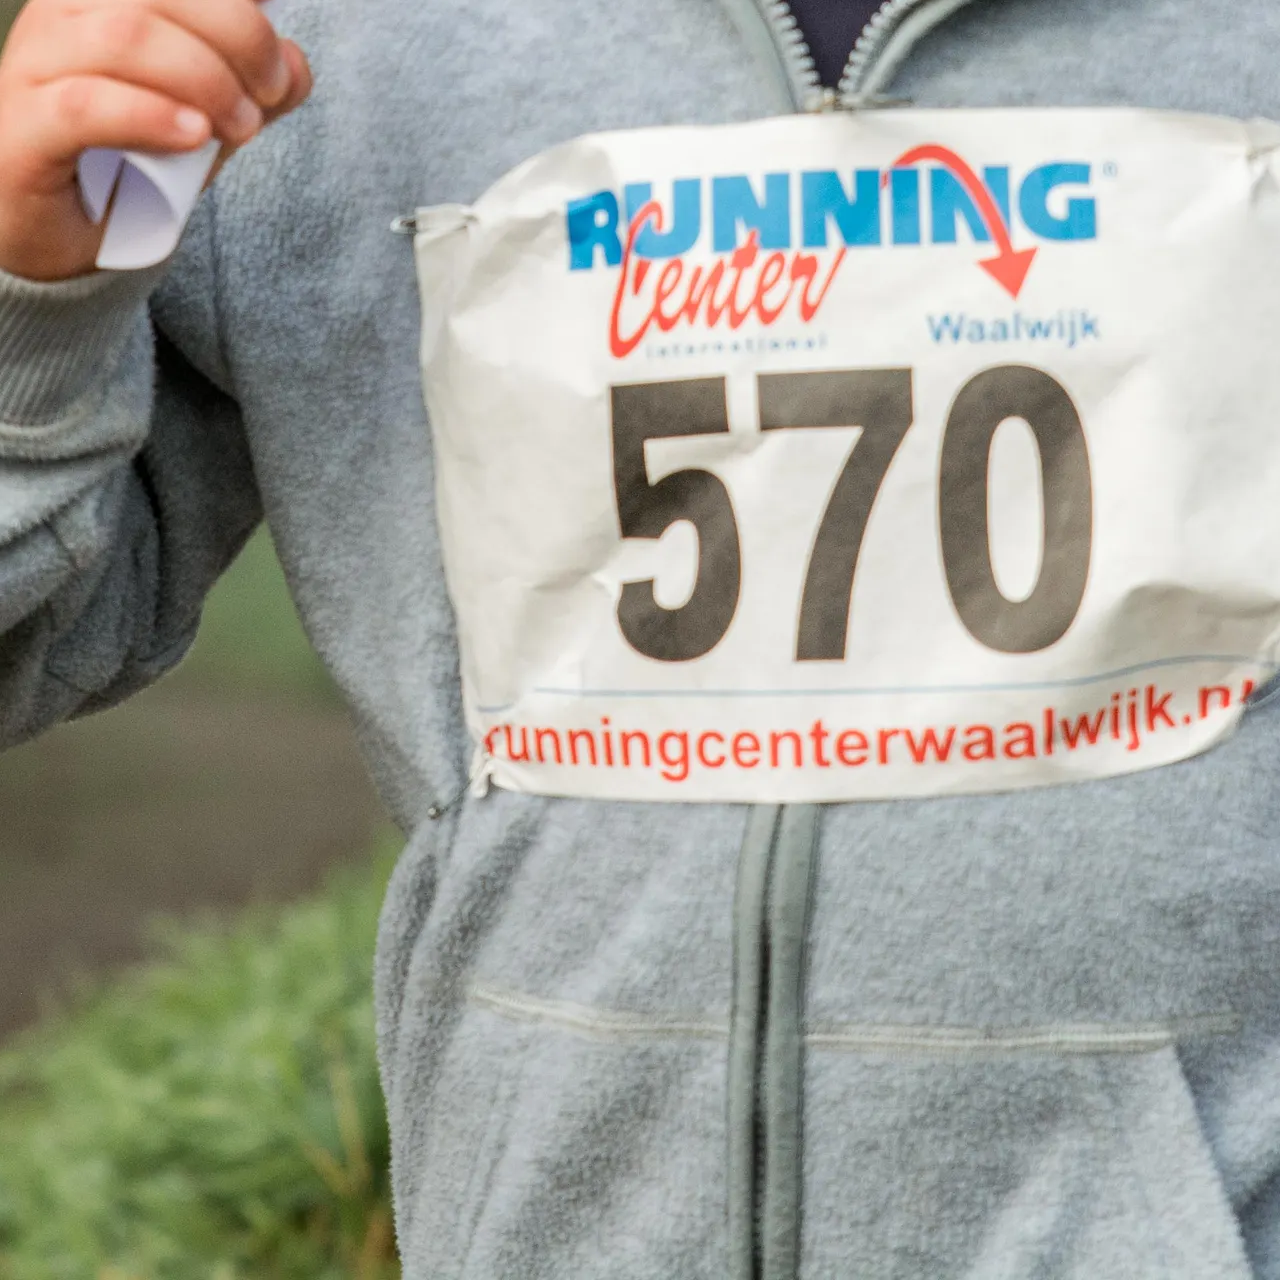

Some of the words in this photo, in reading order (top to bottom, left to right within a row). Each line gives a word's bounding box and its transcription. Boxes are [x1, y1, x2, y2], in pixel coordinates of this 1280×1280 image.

[566, 161, 1098, 271] RUNNING
[608, 200, 847, 358] Center
[927, 309, 1100, 346] Waalwijk
[609, 364, 1094, 662] 570
